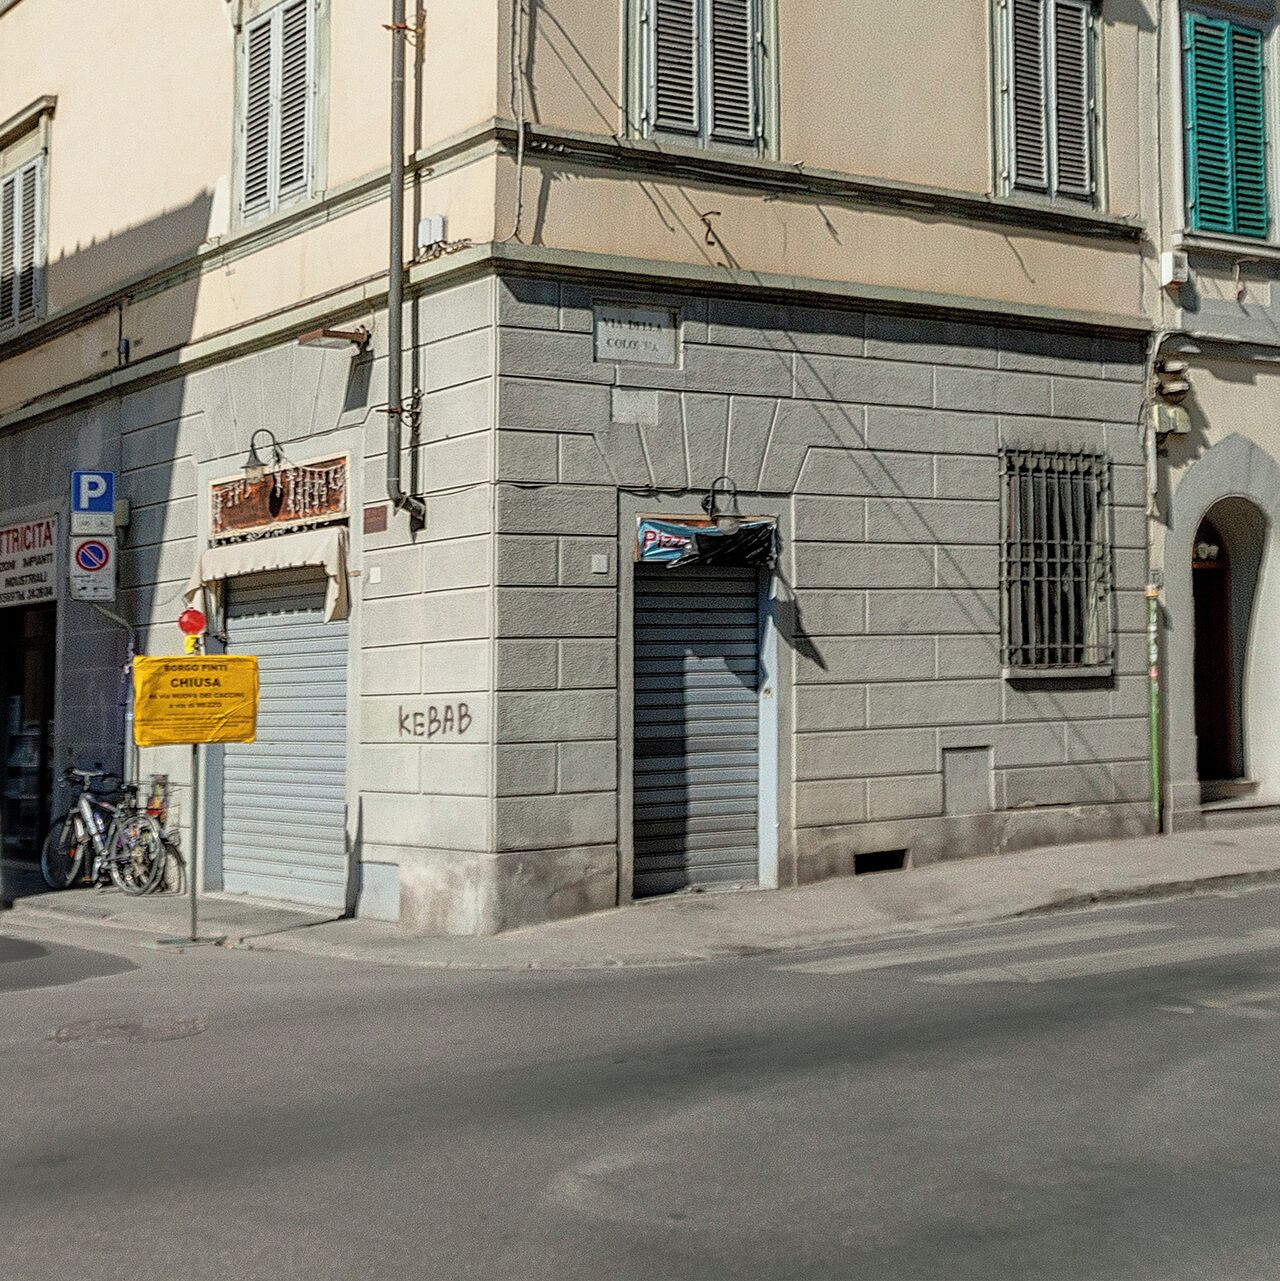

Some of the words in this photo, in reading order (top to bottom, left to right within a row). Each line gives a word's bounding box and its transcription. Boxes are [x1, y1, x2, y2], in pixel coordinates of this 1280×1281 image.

[603, 317, 623, 329] VIA
[628, 320, 663, 332] DELLA
[80, 474, 107, 510] P
[164, 664, 199, 672] BORGO
[202, 664, 228, 672] PINTI
[170, 678, 222, 688] CHIUSA
[398, 702, 473, 738] KEBAB
